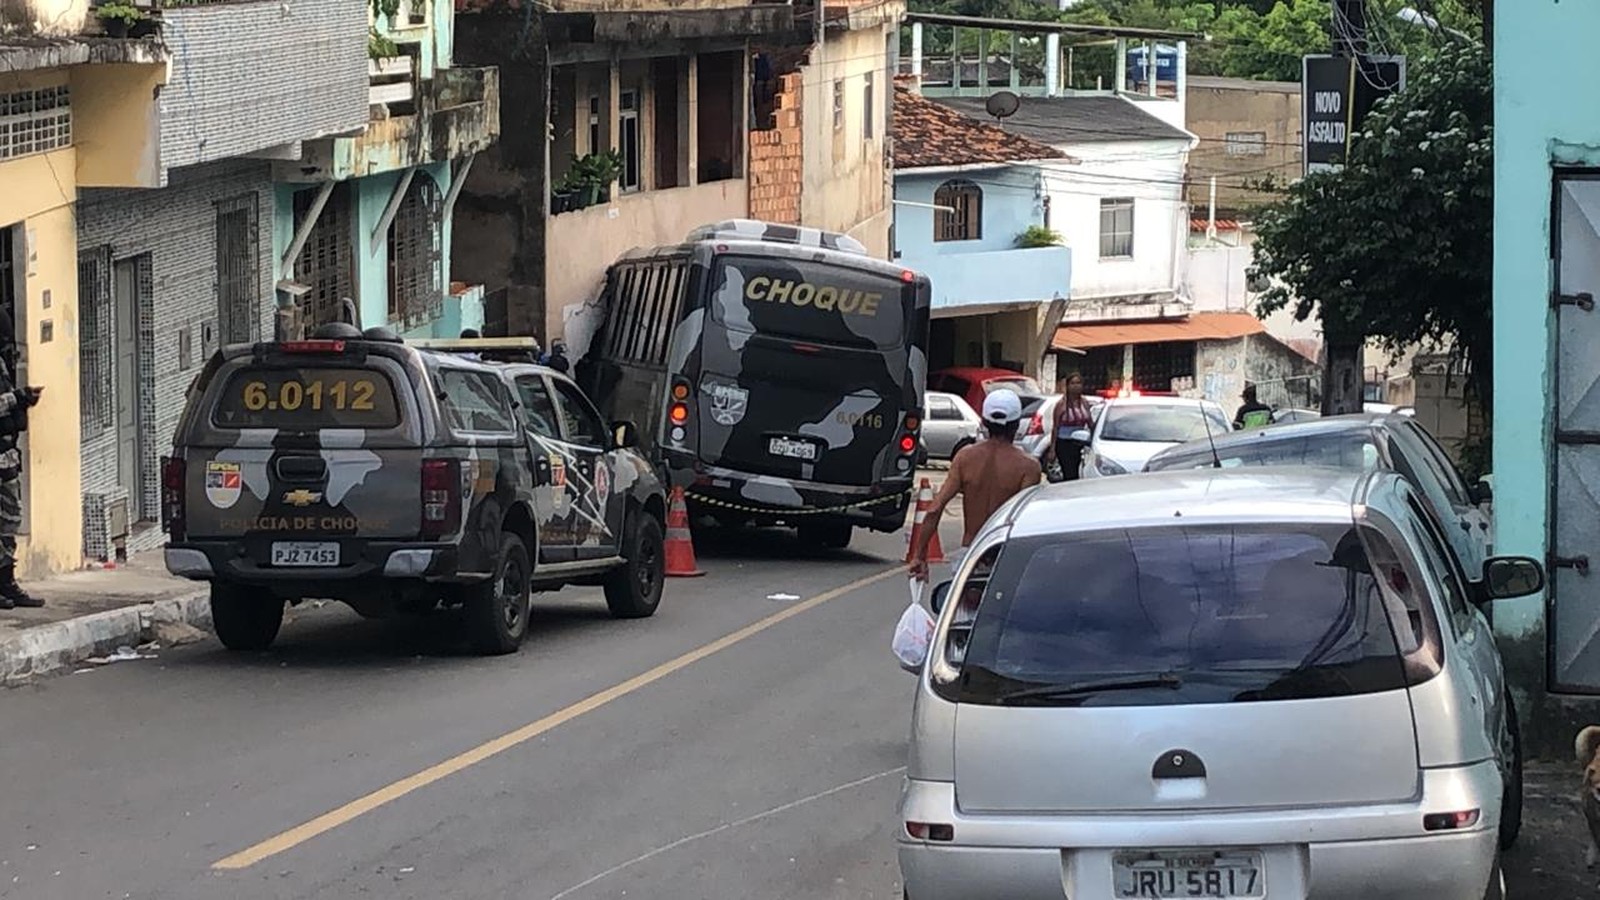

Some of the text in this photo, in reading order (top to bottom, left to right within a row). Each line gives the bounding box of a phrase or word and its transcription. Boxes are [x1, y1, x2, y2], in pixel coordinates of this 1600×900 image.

[1315, 91, 1341, 113] NOVO
[1308, 121, 1346, 143] ASFALTO
[745, 276, 882, 317] CHOQUE
[243, 380, 376, 411] 6.0112
[836, 411, 882, 429] 6.0116
[294, 517, 315, 530] DE
